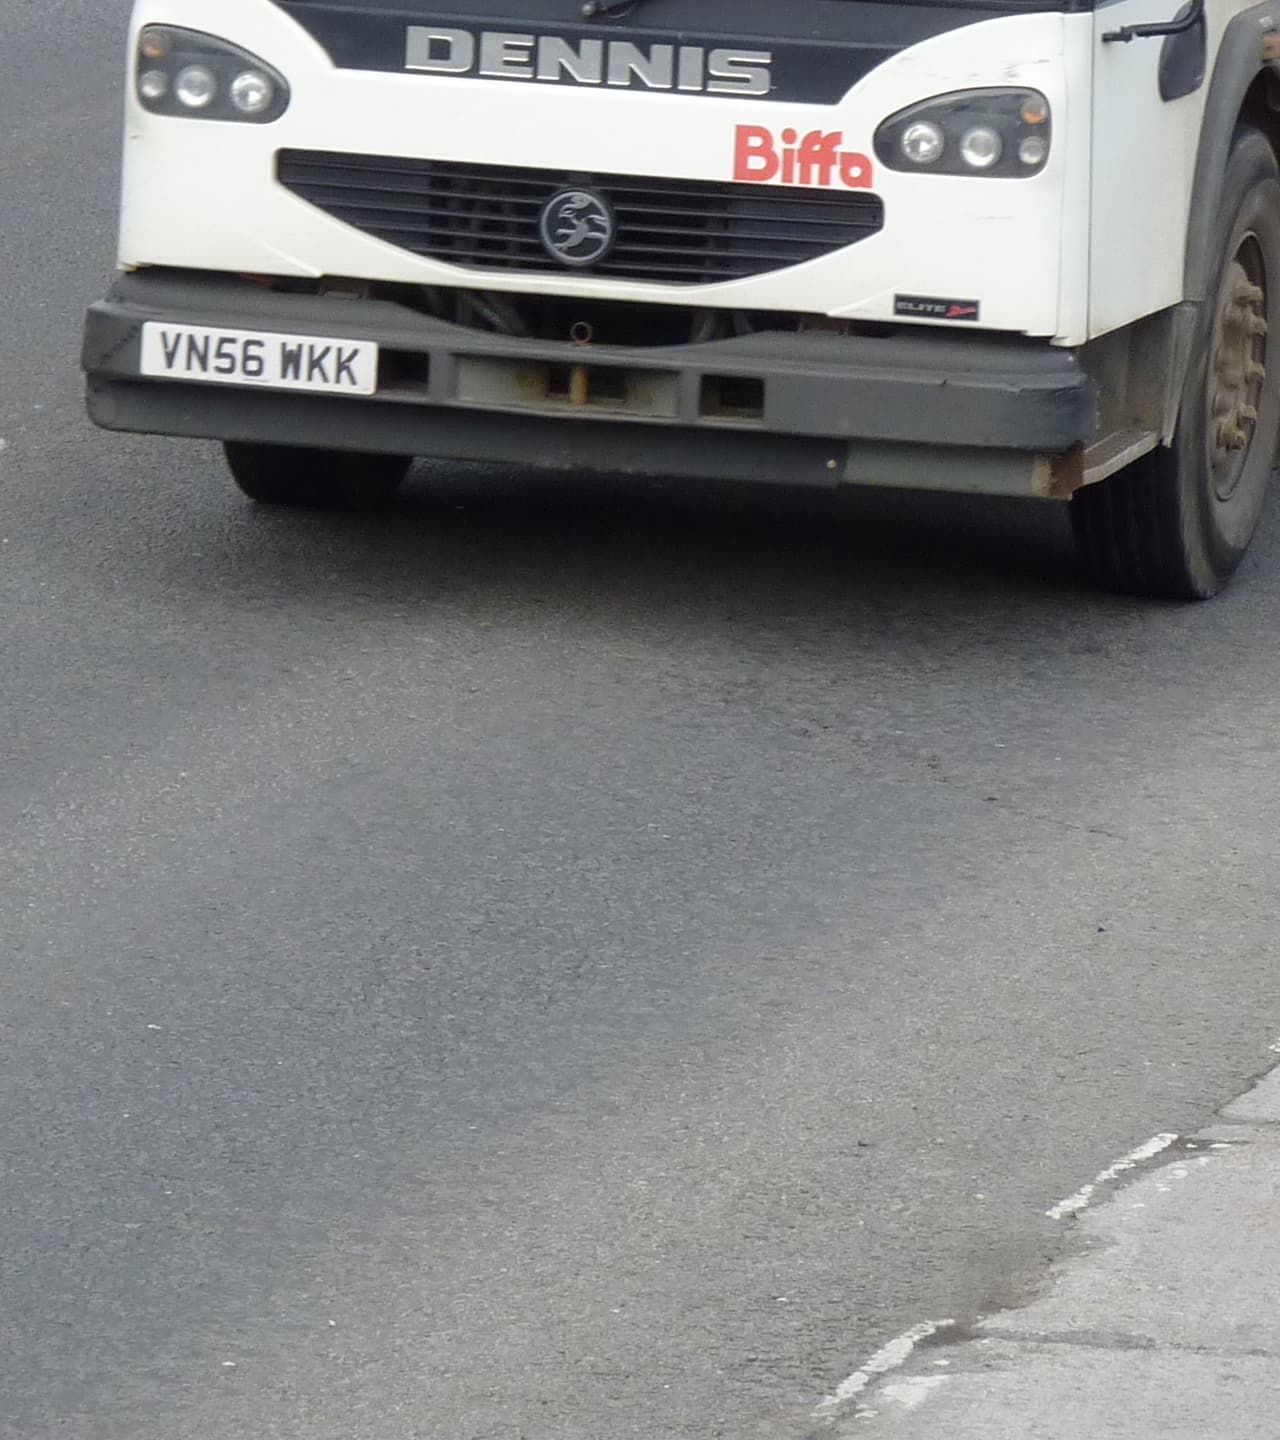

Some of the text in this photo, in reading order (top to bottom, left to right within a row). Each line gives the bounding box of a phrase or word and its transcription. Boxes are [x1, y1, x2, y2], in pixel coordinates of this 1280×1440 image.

[405, 25, 772, 96] DENNIS
[732, 123, 873, 189] Biffa
[161, 331, 359, 386] VN56 WKK
